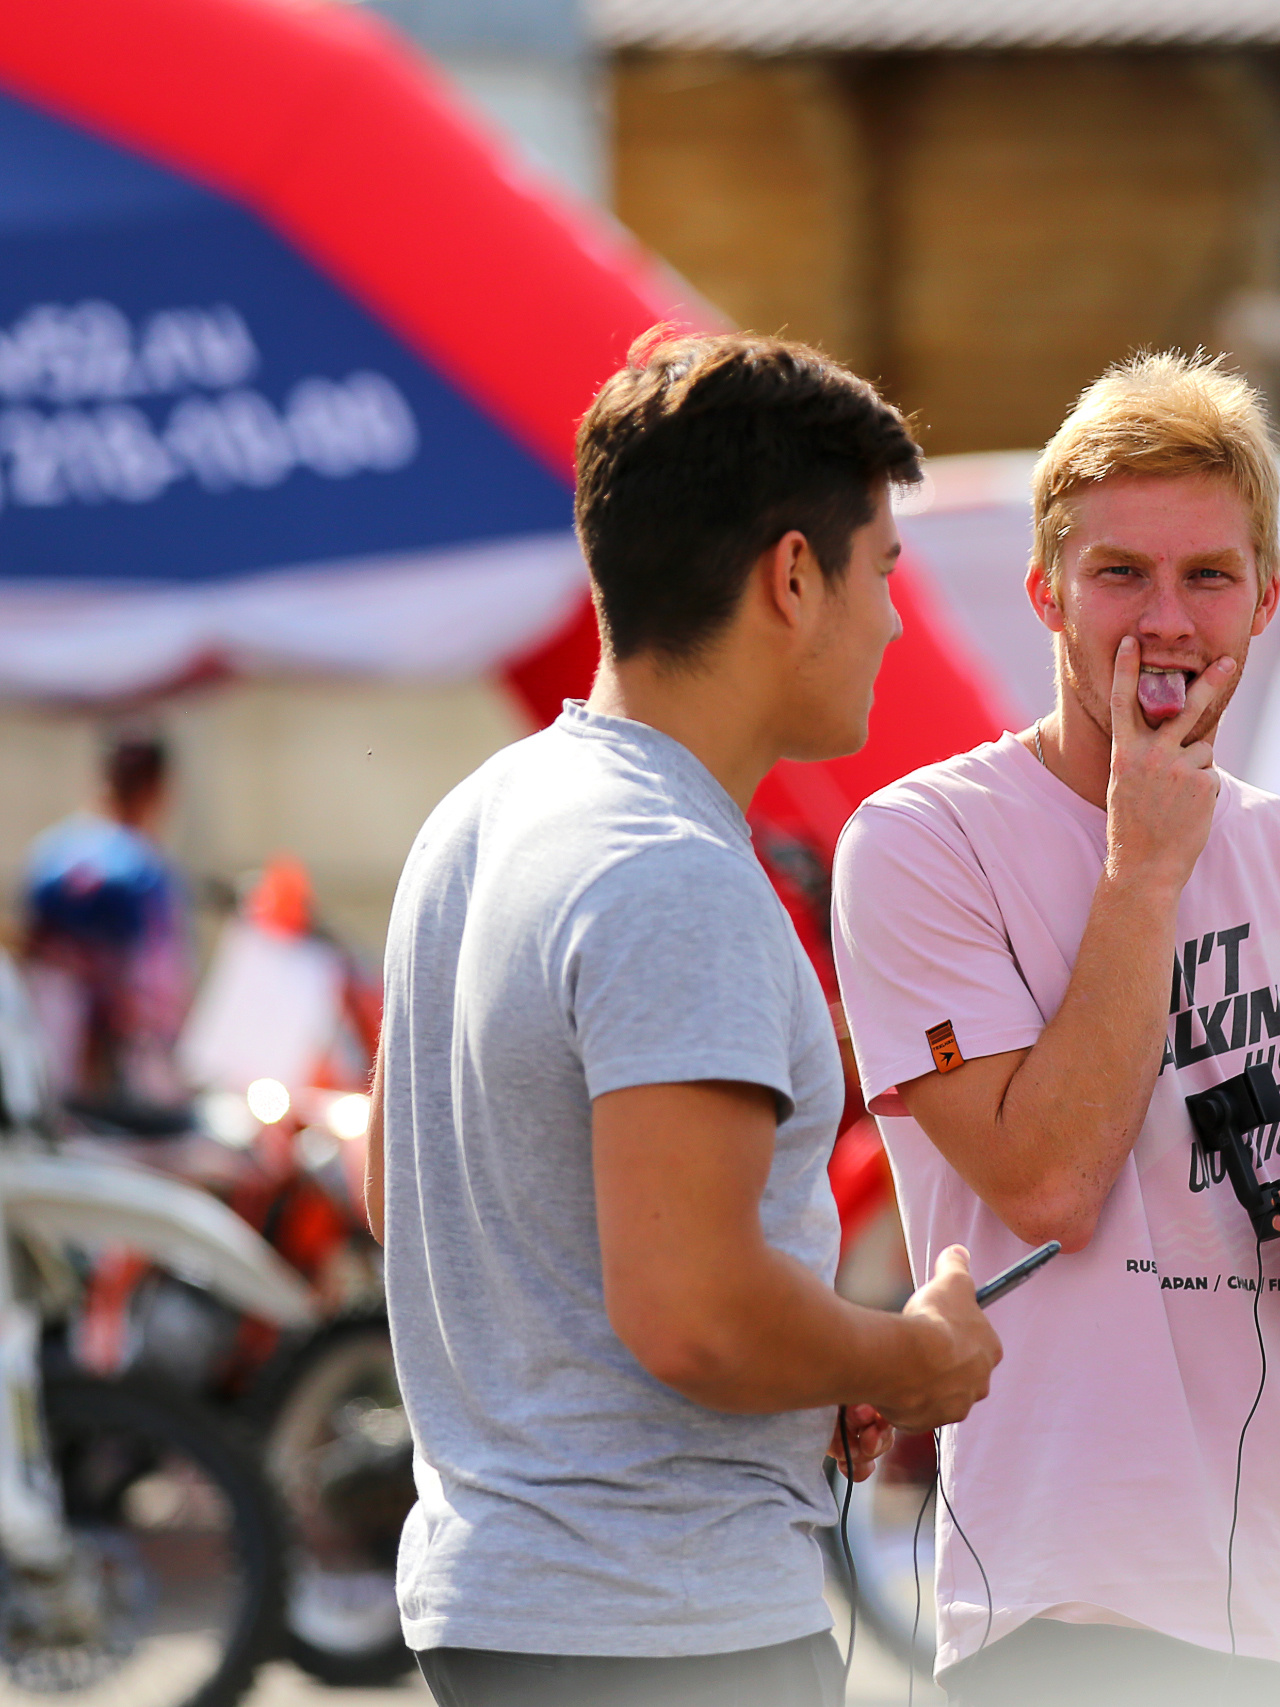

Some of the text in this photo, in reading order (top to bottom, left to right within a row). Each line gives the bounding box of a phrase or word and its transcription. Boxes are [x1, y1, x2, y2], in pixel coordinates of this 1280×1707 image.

[1169, 922, 1250, 1015] N'T
[1126, 1259, 1158, 1274] RUS
[1158, 1276, 1208, 1290] APAN
